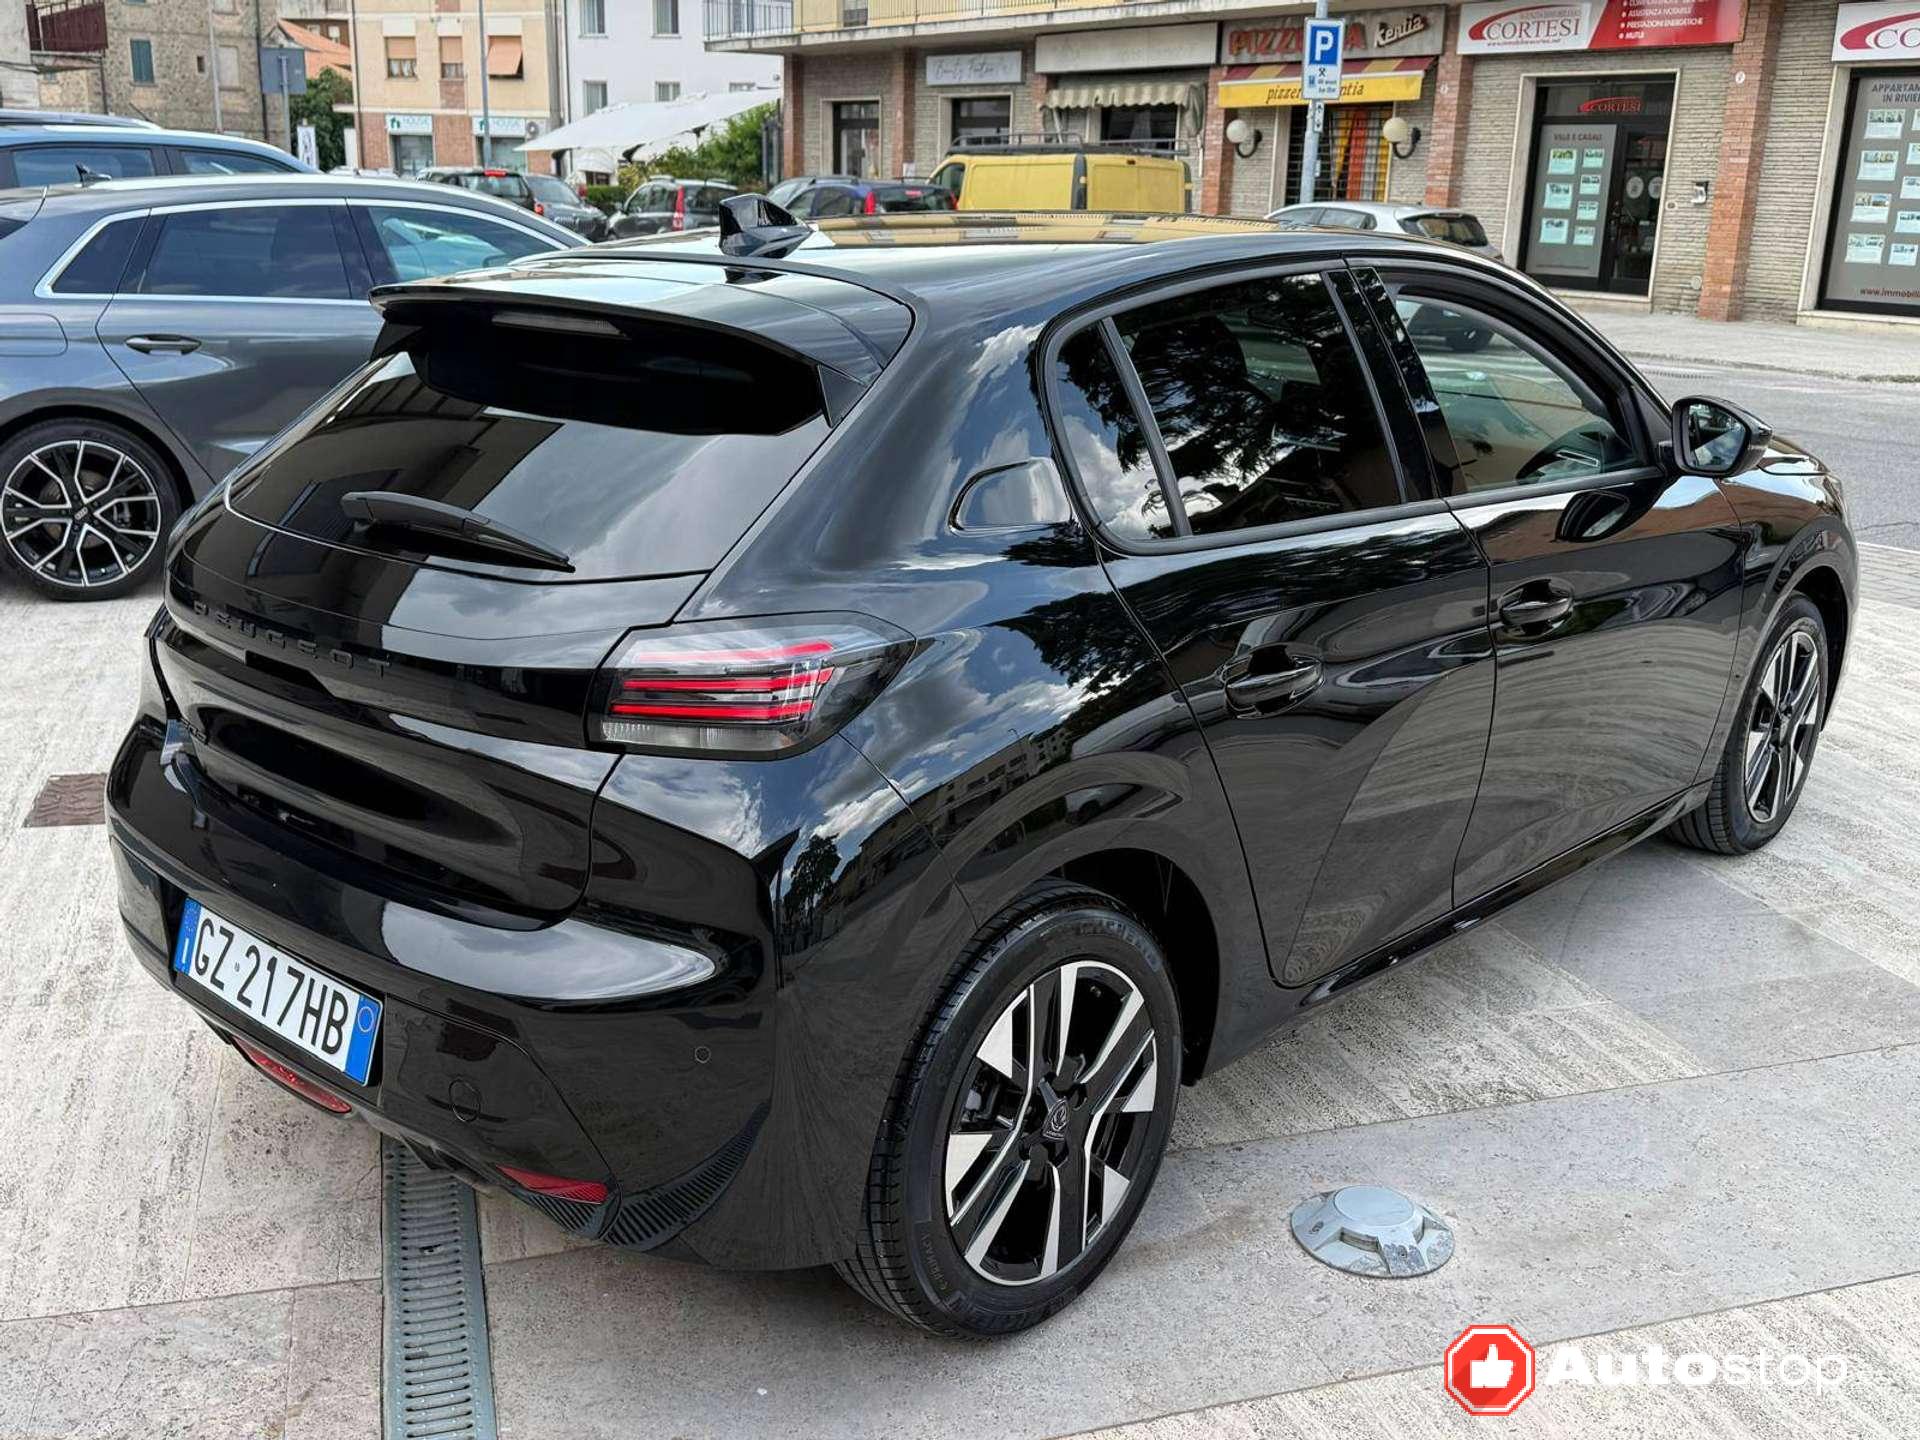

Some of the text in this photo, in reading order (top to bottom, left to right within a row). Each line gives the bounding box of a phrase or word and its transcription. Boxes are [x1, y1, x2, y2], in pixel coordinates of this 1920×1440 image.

[1315, 30, 1333, 61] P
[1486, 18, 1580, 41] CORTESI
[194, 600, 392, 680] PEUGEOT
[194, 917, 349, 1055] GZ 217HB
